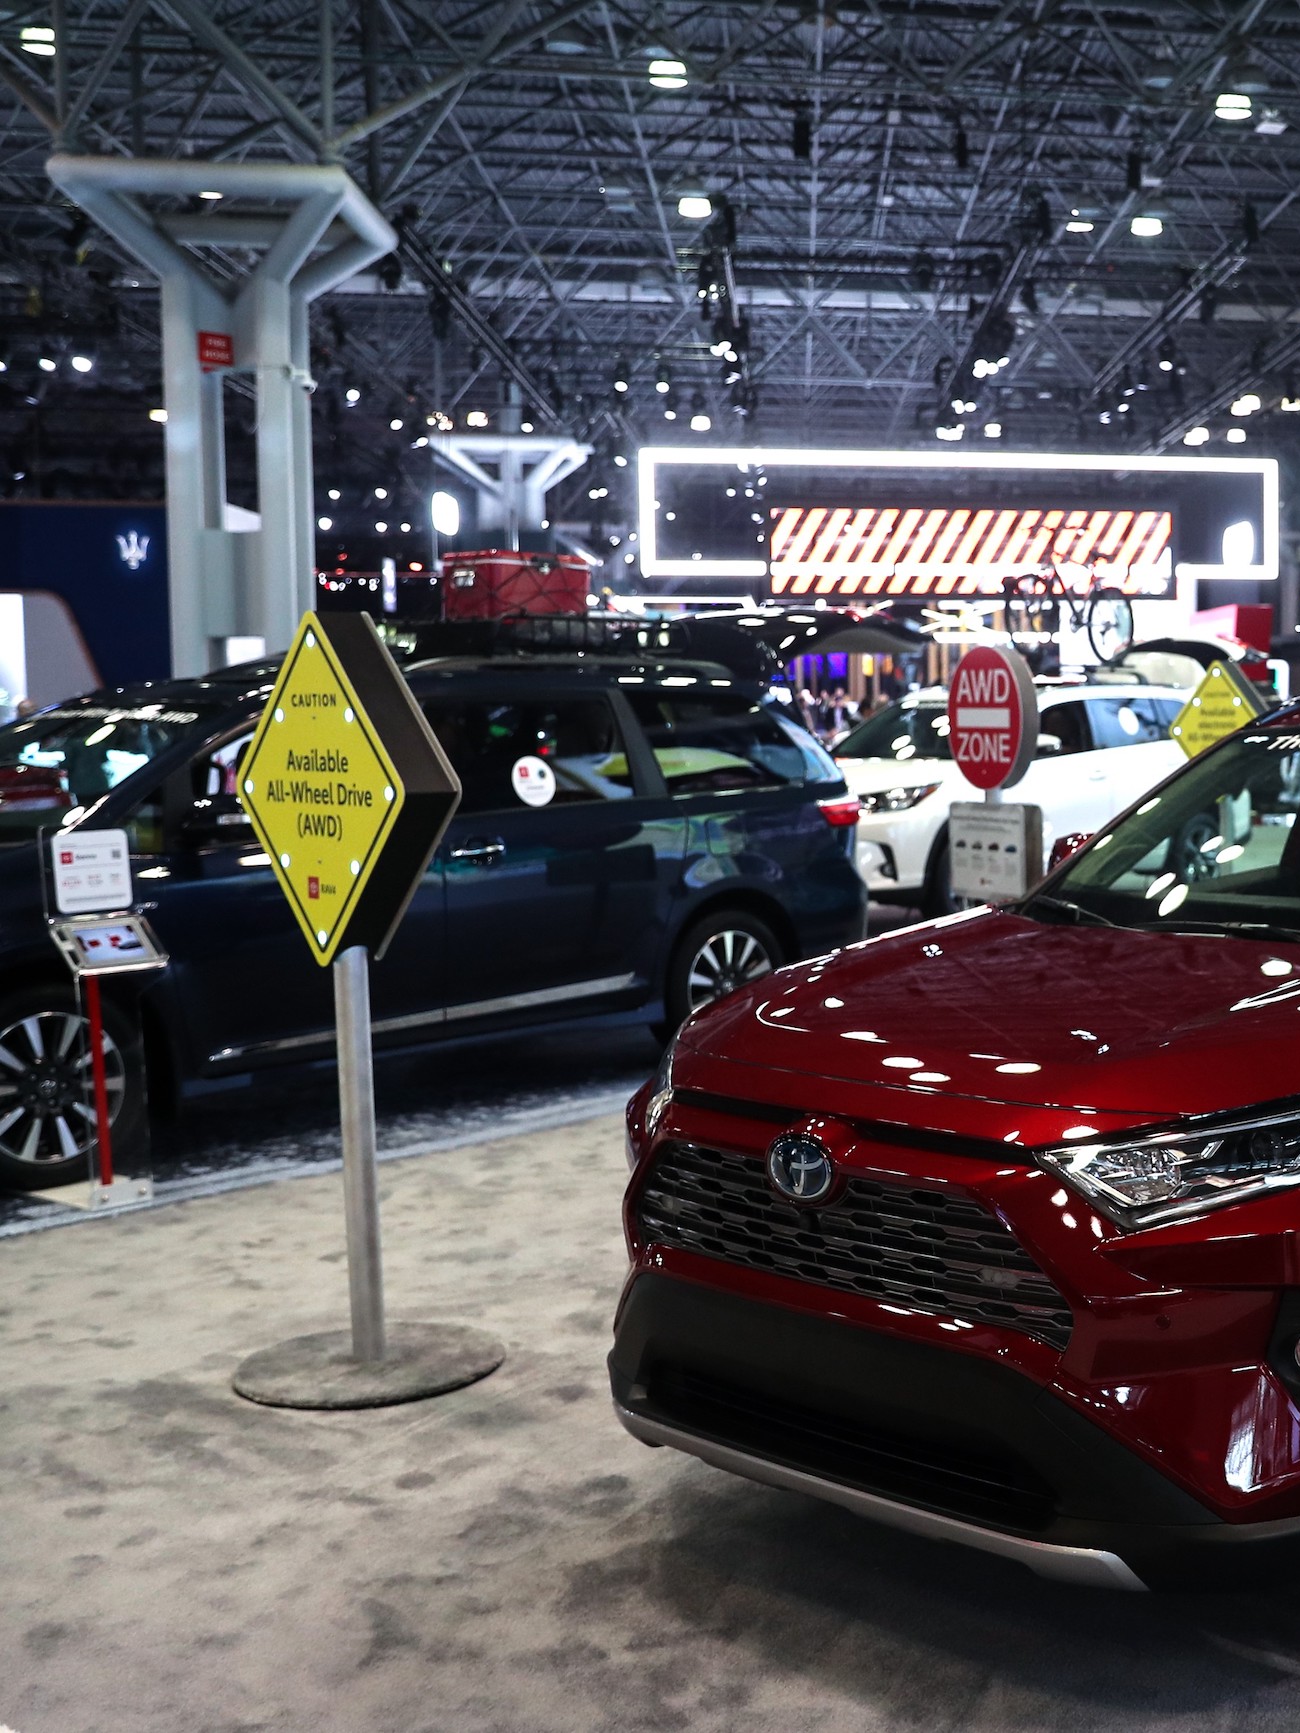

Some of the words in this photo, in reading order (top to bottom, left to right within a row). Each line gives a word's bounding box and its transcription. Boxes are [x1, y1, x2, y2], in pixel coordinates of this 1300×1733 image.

[292, 694, 336, 707] CAUTION
[956, 669, 1010, 704] AWD
[287, 749, 348, 773] Available
[957, 732, 1011, 764] ZONE
[267, 780, 334, 805] All-Wheel
[337, 784, 372, 808] Drive
[297, 812, 343, 842] (AWD)
